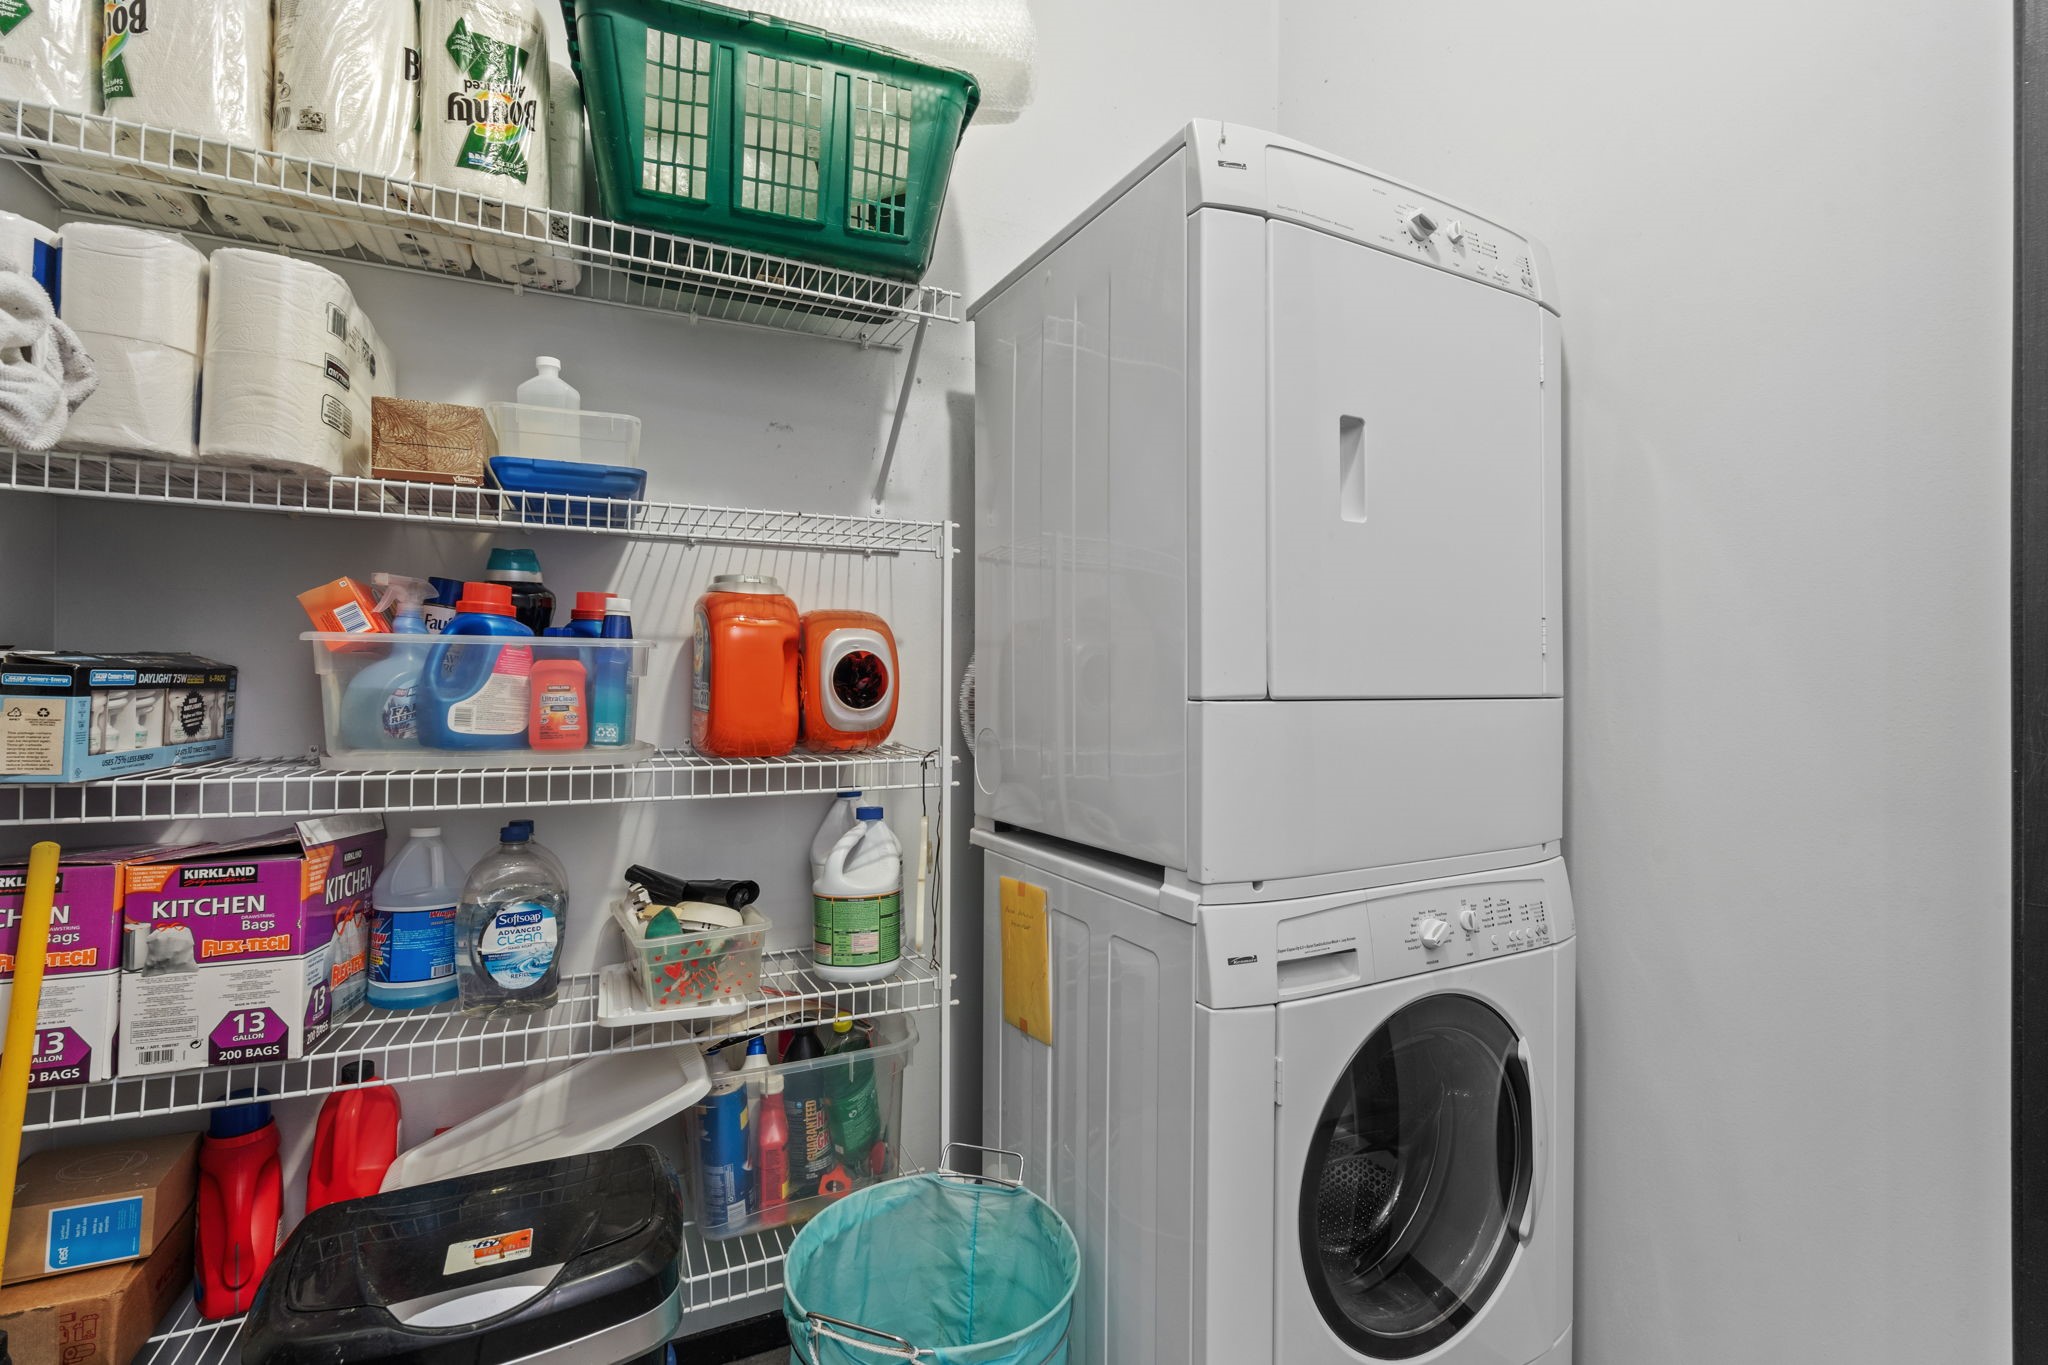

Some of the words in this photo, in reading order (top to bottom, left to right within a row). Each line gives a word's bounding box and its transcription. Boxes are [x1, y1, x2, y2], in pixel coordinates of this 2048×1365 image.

[138, 673, 172, 684] DAYLIGHT
[172, 673, 187, 684] 75W
[541, 694, 577, 703] UltraClean
[102, 758, 114, 767] USES
[114, 755, 127, 766] 75%
[127, 755, 139, 763] LESS
[138, 753, 154, 762] ENERGY
[183, 866, 256, 880] KIRKLAND
[184, 877, 255, 887] Signature
[325, 865, 373, 905] KITCHEN
[152, 895, 265, 919] KITCHEN
[241, 919, 275, 931] Bags
[498, 912, 541, 926] Softsoap
[498, 925, 542, 936] ADVANCED
[202, 934, 290, 958] FLEX-TECH
[497, 932, 542, 946] CLEAN
[0, 948, 98, 972] FL-TECH
[313, 985, 326, 1013] 13
[233, 1011, 265, 1034] 13
[232, 1032, 265, 1041] GALLON
[306, 1029, 316, 1045] 200
[316, 1019, 329, 1038] BAGS
[32, 1054, 62, 1063] ALLON
[219, 1050, 242, 1061] 200
[245, 1045, 280, 1058] BAGS
[40, 1067, 80, 1082] BAGS
[805, 1099, 817, 1161] GUARANTEED
[57, 1246, 69, 1265] nest
